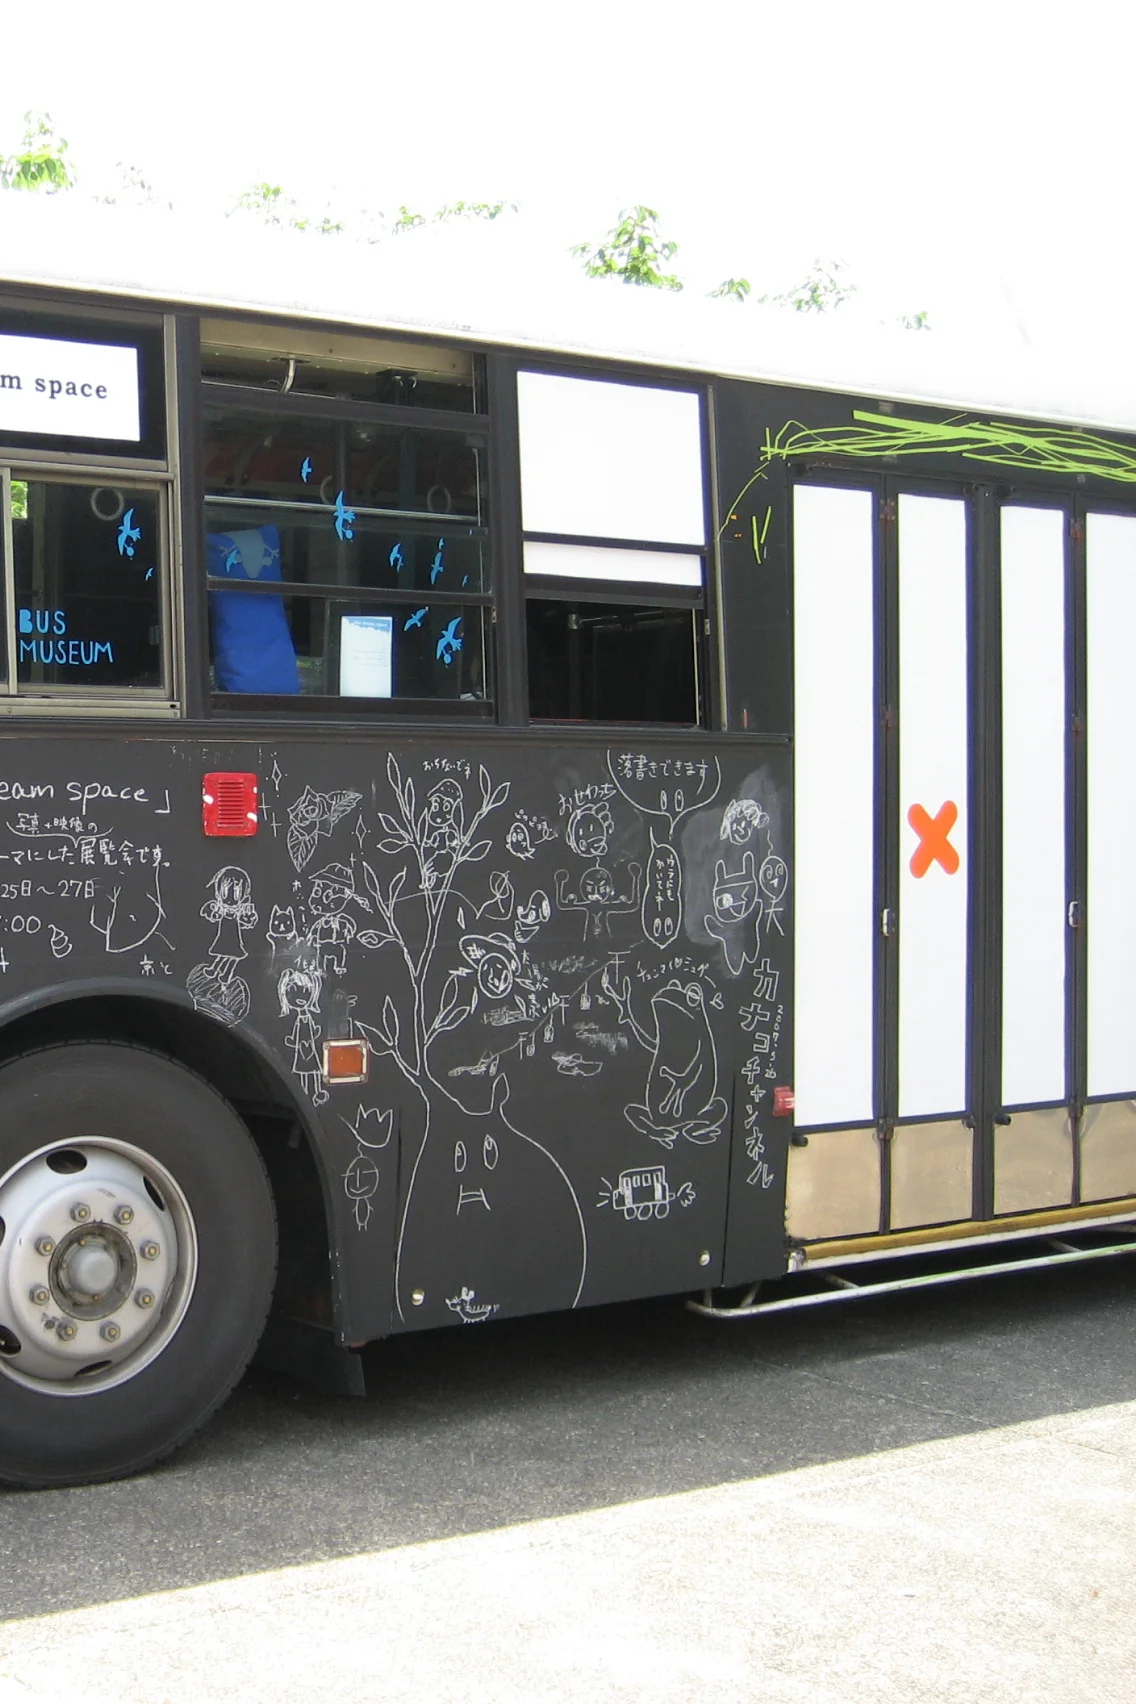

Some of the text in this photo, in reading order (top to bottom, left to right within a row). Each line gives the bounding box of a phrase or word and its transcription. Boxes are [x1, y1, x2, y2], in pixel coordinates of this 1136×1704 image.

[35, 376, 108, 400] space
[19, 608, 66, 635] BUS
[19, 639, 114, 665] MUSEUM
